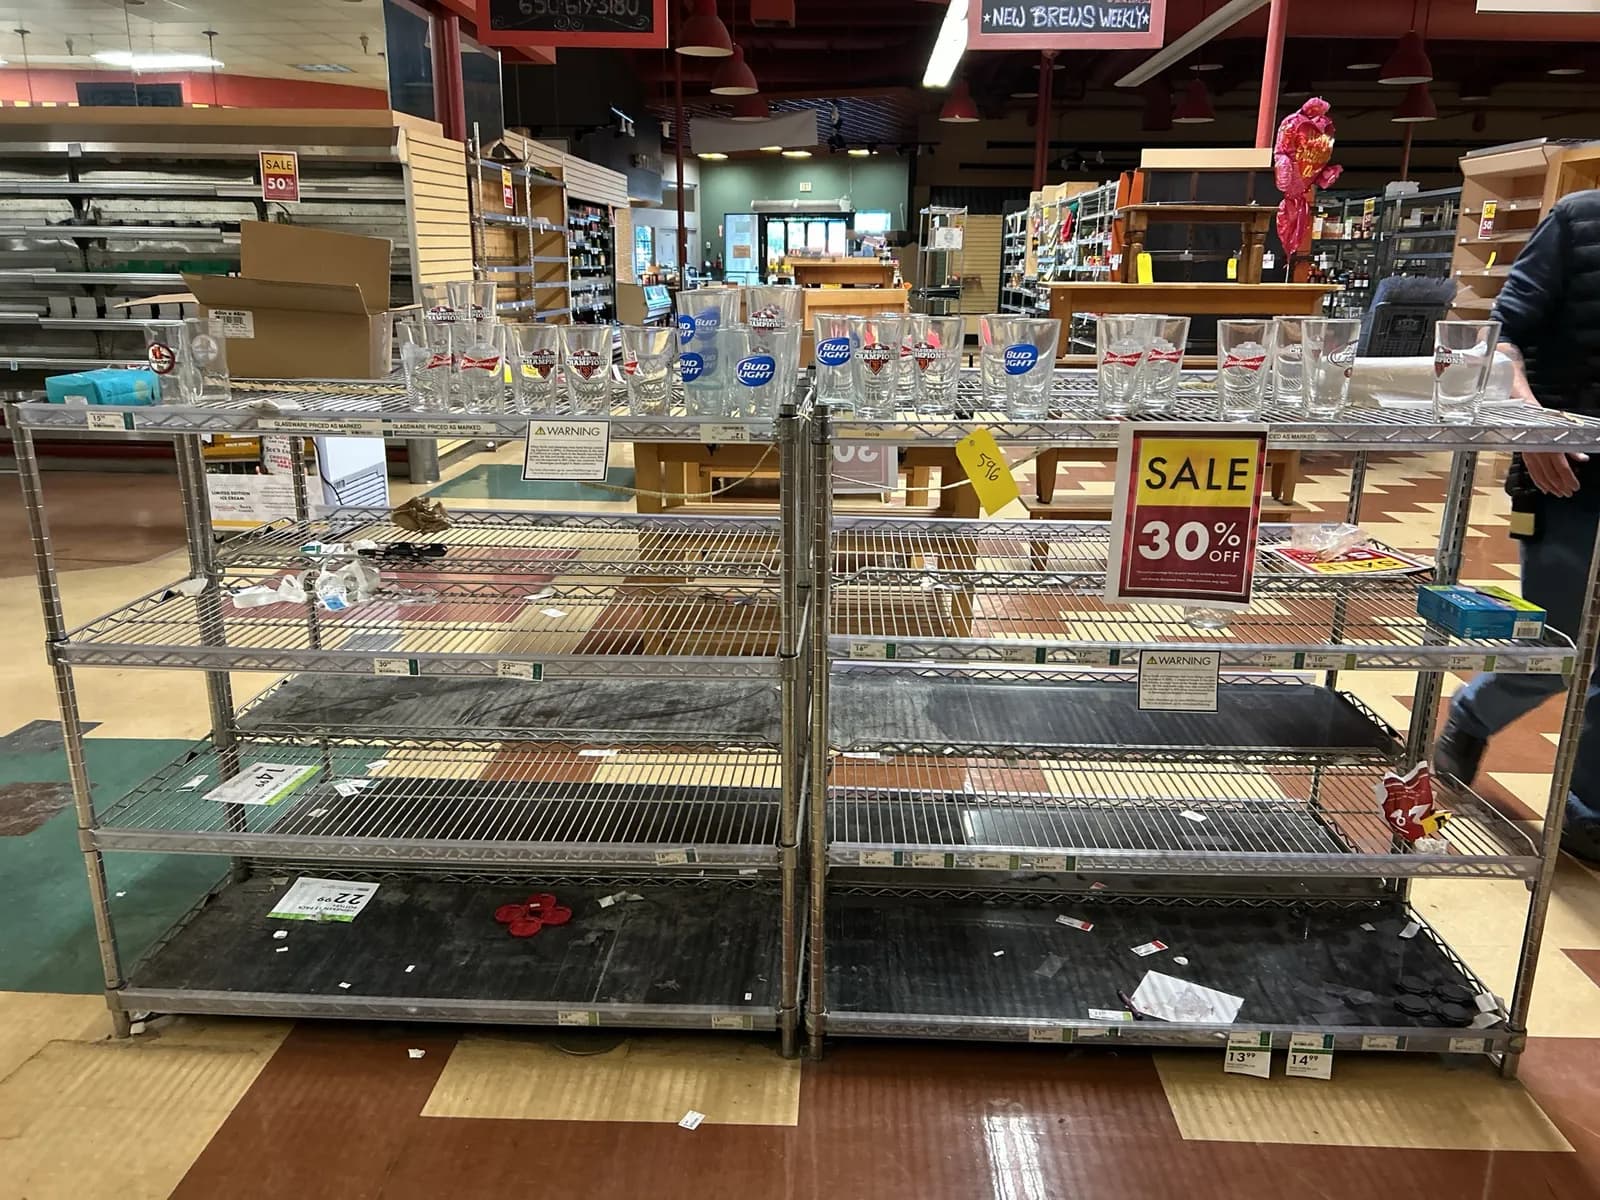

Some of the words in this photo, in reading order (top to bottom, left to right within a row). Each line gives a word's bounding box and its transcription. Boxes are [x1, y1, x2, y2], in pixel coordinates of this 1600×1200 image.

[992, 7, 1026, 27] NEW
[1030, 5, 1095, 28] BREWS
[1100, 6, 1145, 28] WEEKLY
[265, 159, 293, 170] SALE
[823, 342, 850, 352] BUD
[820, 351, 850, 359] LIGHT
[1006, 350, 1032, 359] BUD
[742, 362, 770, 371] BUD
[1006, 359, 1036, 367] IGHT
[739, 370, 773, 378] LIGHT
[274, 420, 306, 428] GLASSWARE
[308, 421, 330, 429] PRICED
[331, 422, 338, 430] AS
[338, 422, 362, 430] MARKED
[546, 426, 601, 437] WARNING
[977, 452, 1001, 481] 596
[1145, 457, 1250, 491] SALE
[1138, 520, 1241, 562] 30%
[1209, 550, 1241, 564] OFF
[1158, 656, 1212, 666] WARNING
